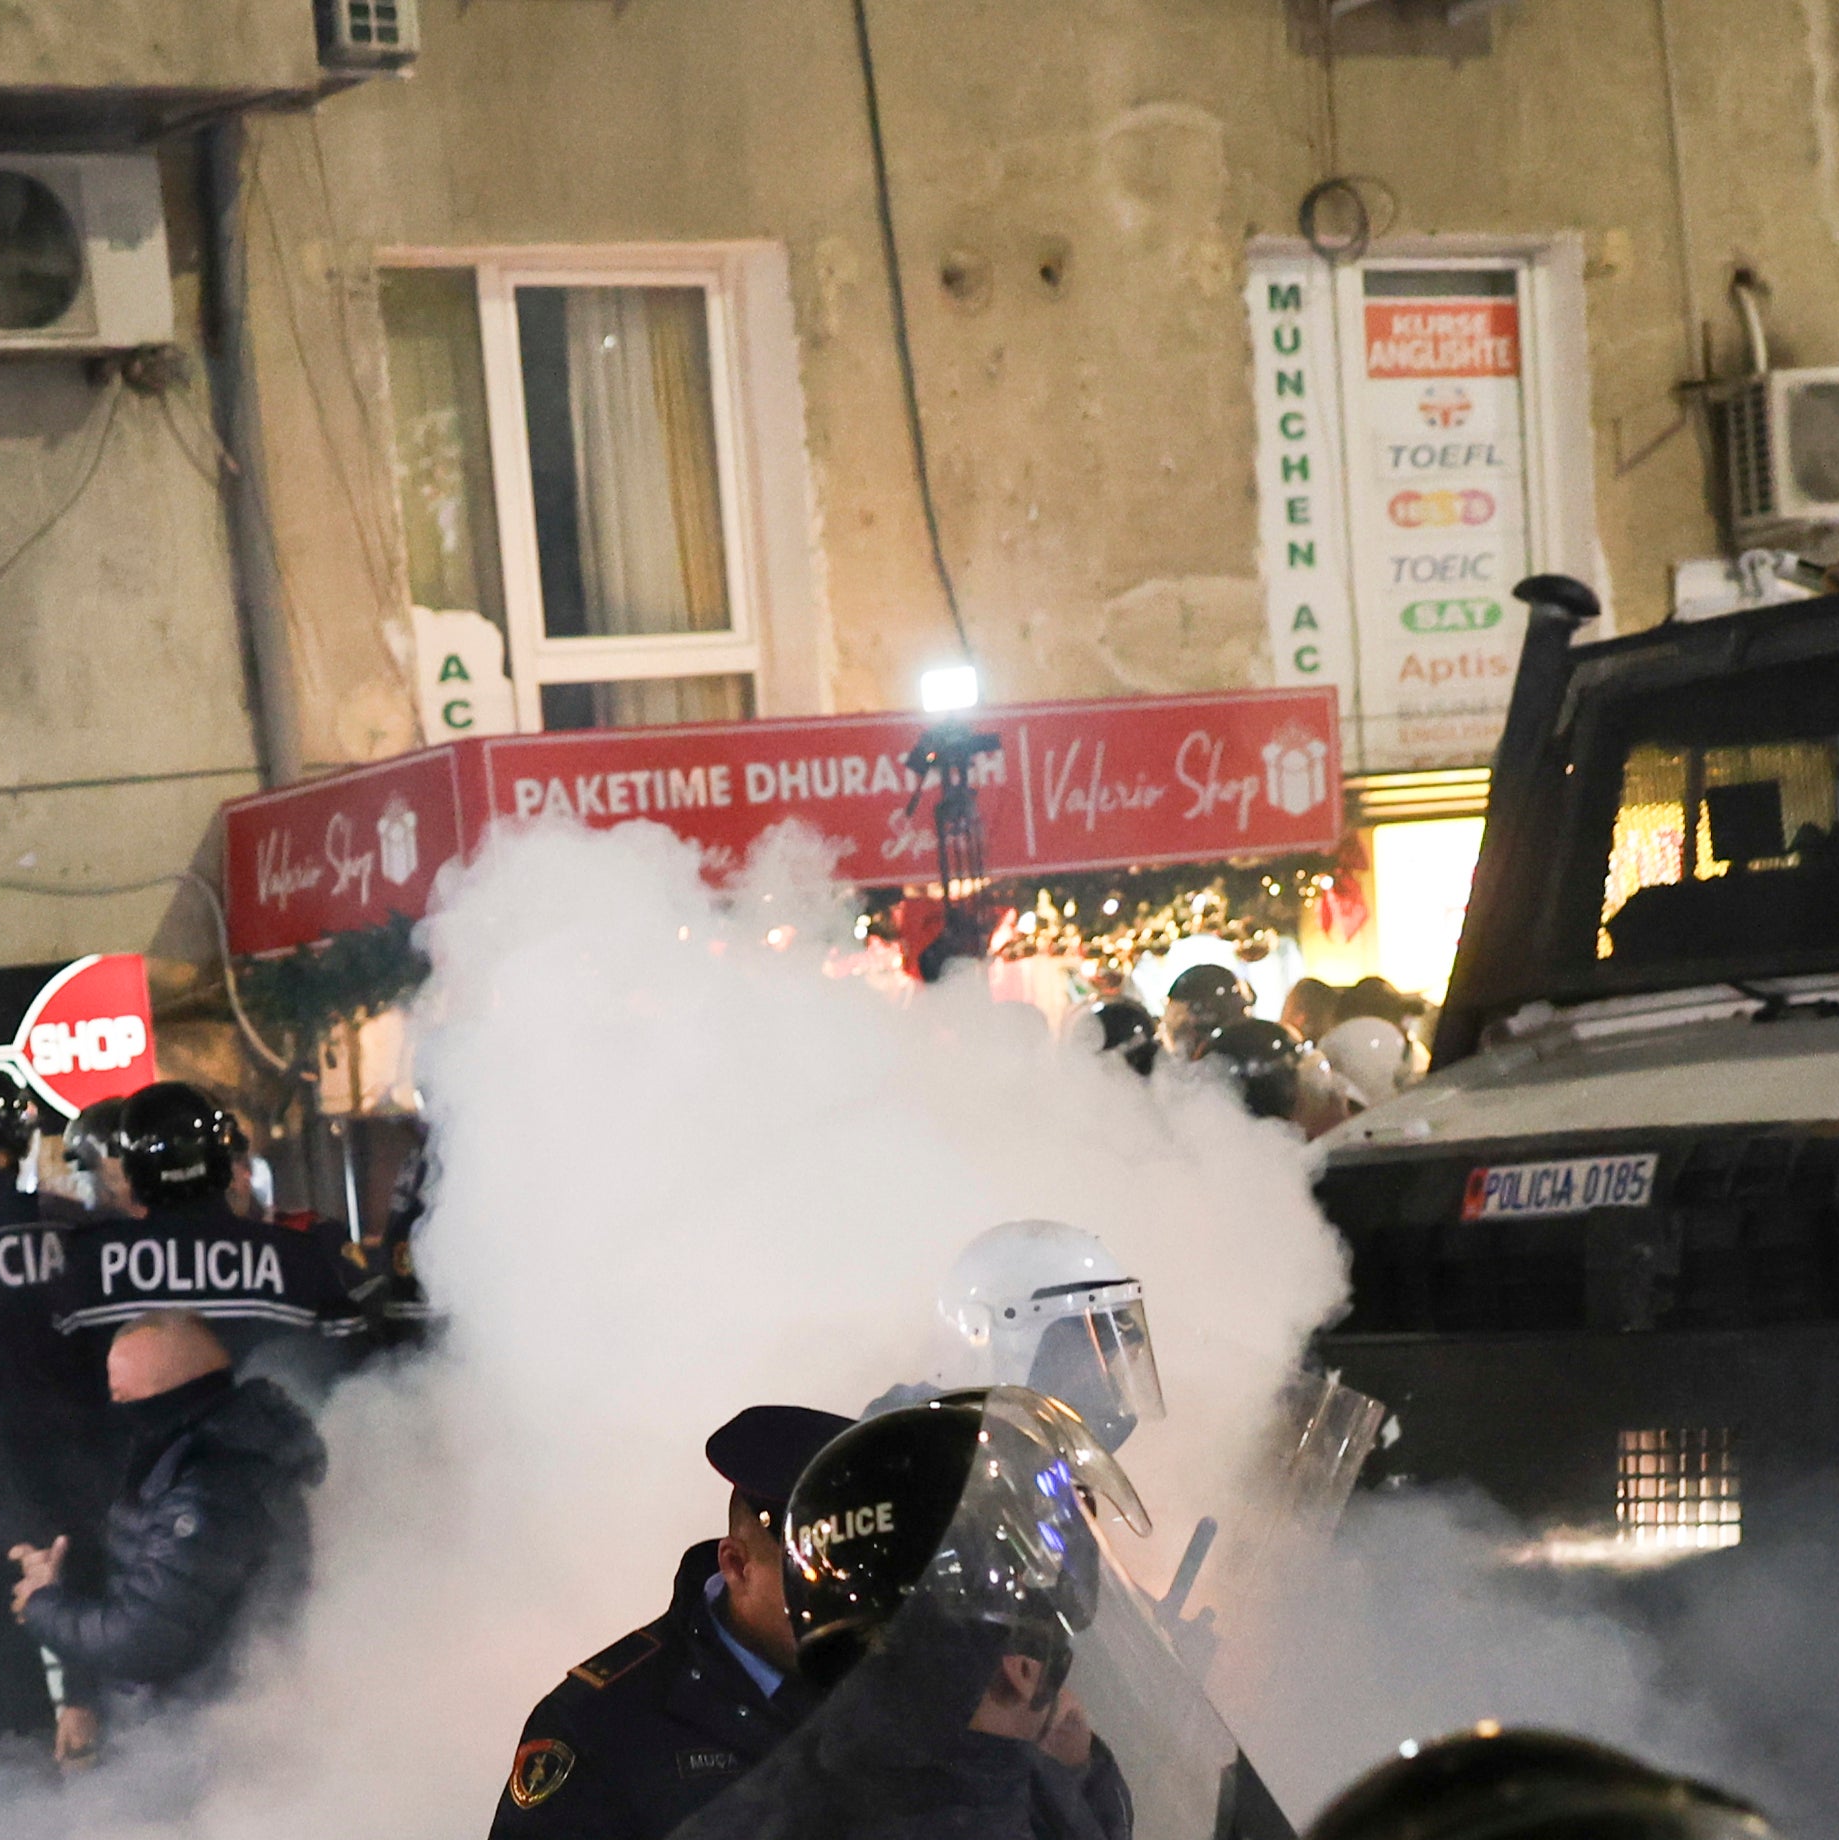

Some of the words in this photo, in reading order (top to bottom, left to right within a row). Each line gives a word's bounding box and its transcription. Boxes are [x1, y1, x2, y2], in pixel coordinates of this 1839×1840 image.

[1388, 442, 1504, 469] TOEFL
[1390, 551, 1495, 584] TOEIC
[1292, 603, 1321, 673] AC
[1398, 648, 1511, 688] Aptis
[513, 764, 733, 821] PAKETIME
[1174, 729, 1260, 833] Shop
[29, 1015, 147, 1077] SHOP
[1483, 1167, 1574, 1213] POLICIA
[1584, 1161, 1647, 1204] 0185
[100, 1237, 286, 1297] POLICIA
[798, 1501, 895, 1556] POLICE
